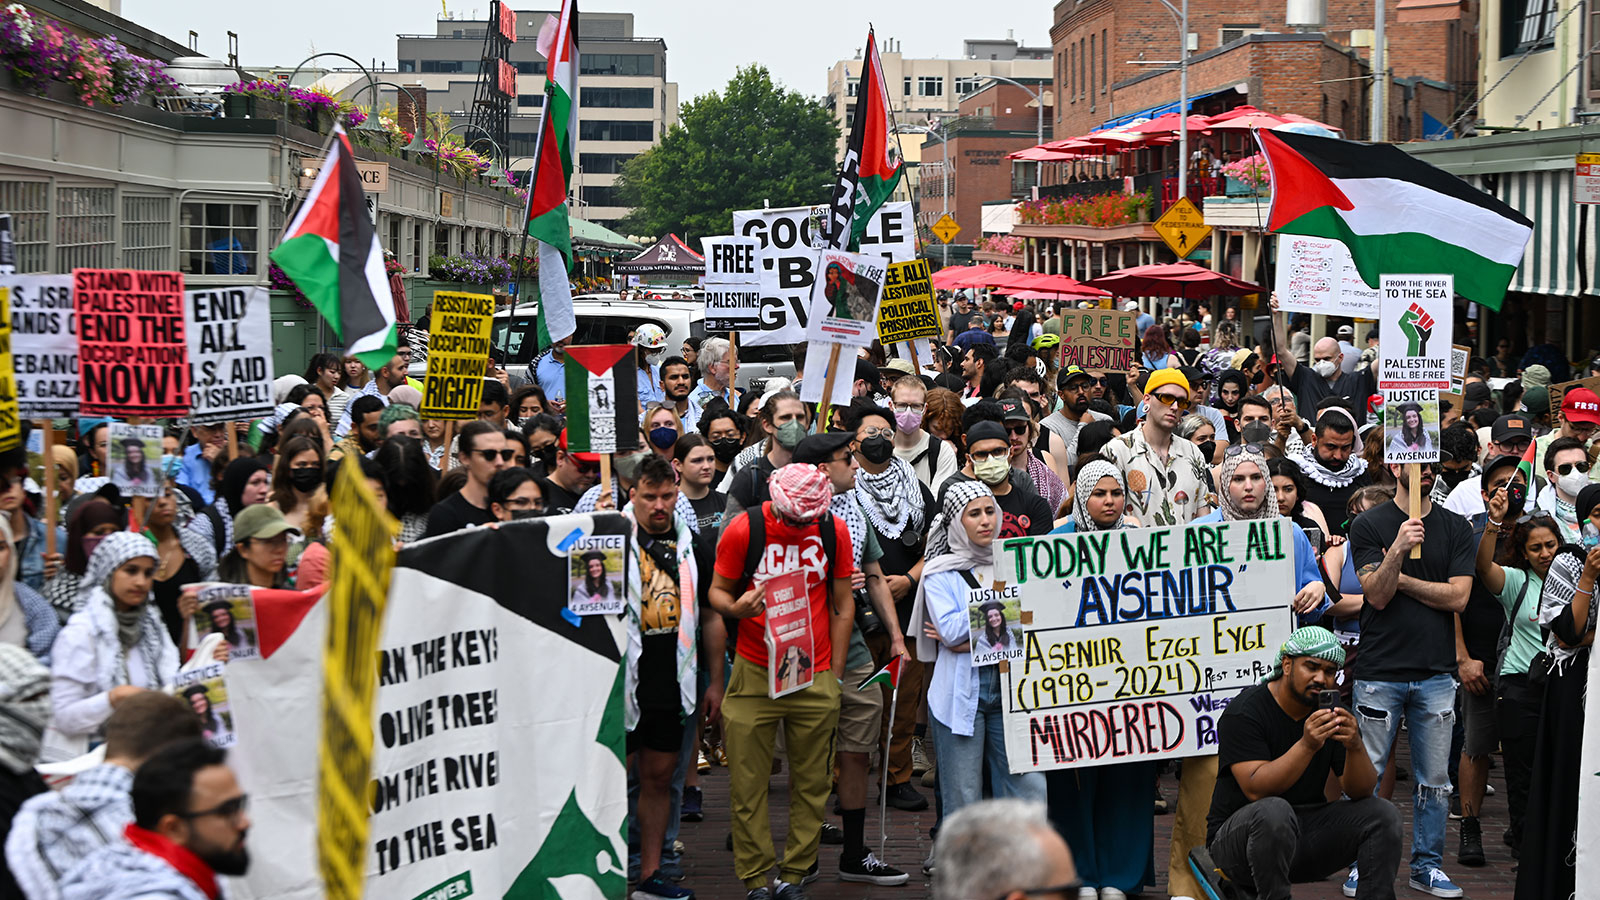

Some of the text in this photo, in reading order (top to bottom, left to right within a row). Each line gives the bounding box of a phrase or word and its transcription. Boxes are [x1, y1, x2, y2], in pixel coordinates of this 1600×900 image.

[1161, 221, 1204, 229] PEDESTRIANS
[712, 244, 754, 273] FREE
[76, 272, 180, 292] STAND WITH
[866, 265, 884, 285] FREE
[1386, 280, 1408, 288] FROM
[79, 293, 181, 314] PALESTINE!
[706, 292, 760, 308] PALESTINE!
[1386, 289, 1447, 299] TO THE SEA
[193, 290, 246, 322] END
[435, 295, 493, 316] RESISTANCE
[881, 300, 931, 319] POLITICAL
[80, 315, 184, 344] END THE
[441, 315, 482, 334] AGAINST
[879, 314, 937, 335] PRISONERS
[1063, 314, 1131, 337] FREE
[200, 323, 245, 354] ALL
[430, 335, 489, 355] OCCUPATION
[80, 345, 185, 364] OCCUPATION
[1060, 345, 1135, 370] PALESTINE
[1385, 359, 1446, 369] PALESTINE
[231, 357, 266, 384] AID
[430, 357, 483, 377] IS A HUMAN
[1384, 371, 1446, 379] WILL BE FREE
[82, 364, 184, 404] NOW!
[424, 376, 480, 409] RIGHT!
[206, 385, 269, 410] ISRAEL!
[1388, 389, 1437, 402] JUSTICE
[112, 425, 159, 438] JUSTICE
[1388, 452, 1438, 461] 4 AYSENUR
[572, 538, 621, 550] JUSTICE
[1003, 520, 1286, 584] TODAY WE ARE ALL
[773, 587, 795, 603] FIGHT
[969, 586, 1019, 603] JUSTICE
[580, 602, 621, 612] AYSENUR
[1146, 627, 1202, 662] EZGI
[1214, 616, 1268, 656] EYGI
[411, 635, 446, 679] THE
[983, 650, 1023, 662] AYSENUR
[1017, 658, 1203, 713] (1998-2024)
[1206, 660, 1274, 690] REST IN PEA
[379, 699, 435, 749] OLIVE
[1030, 697, 1234, 767] MURDERED WES
[404, 758, 439, 802] THE
[443, 751, 498, 791] RIVE
[375, 813, 498, 876] TO THE SEA
